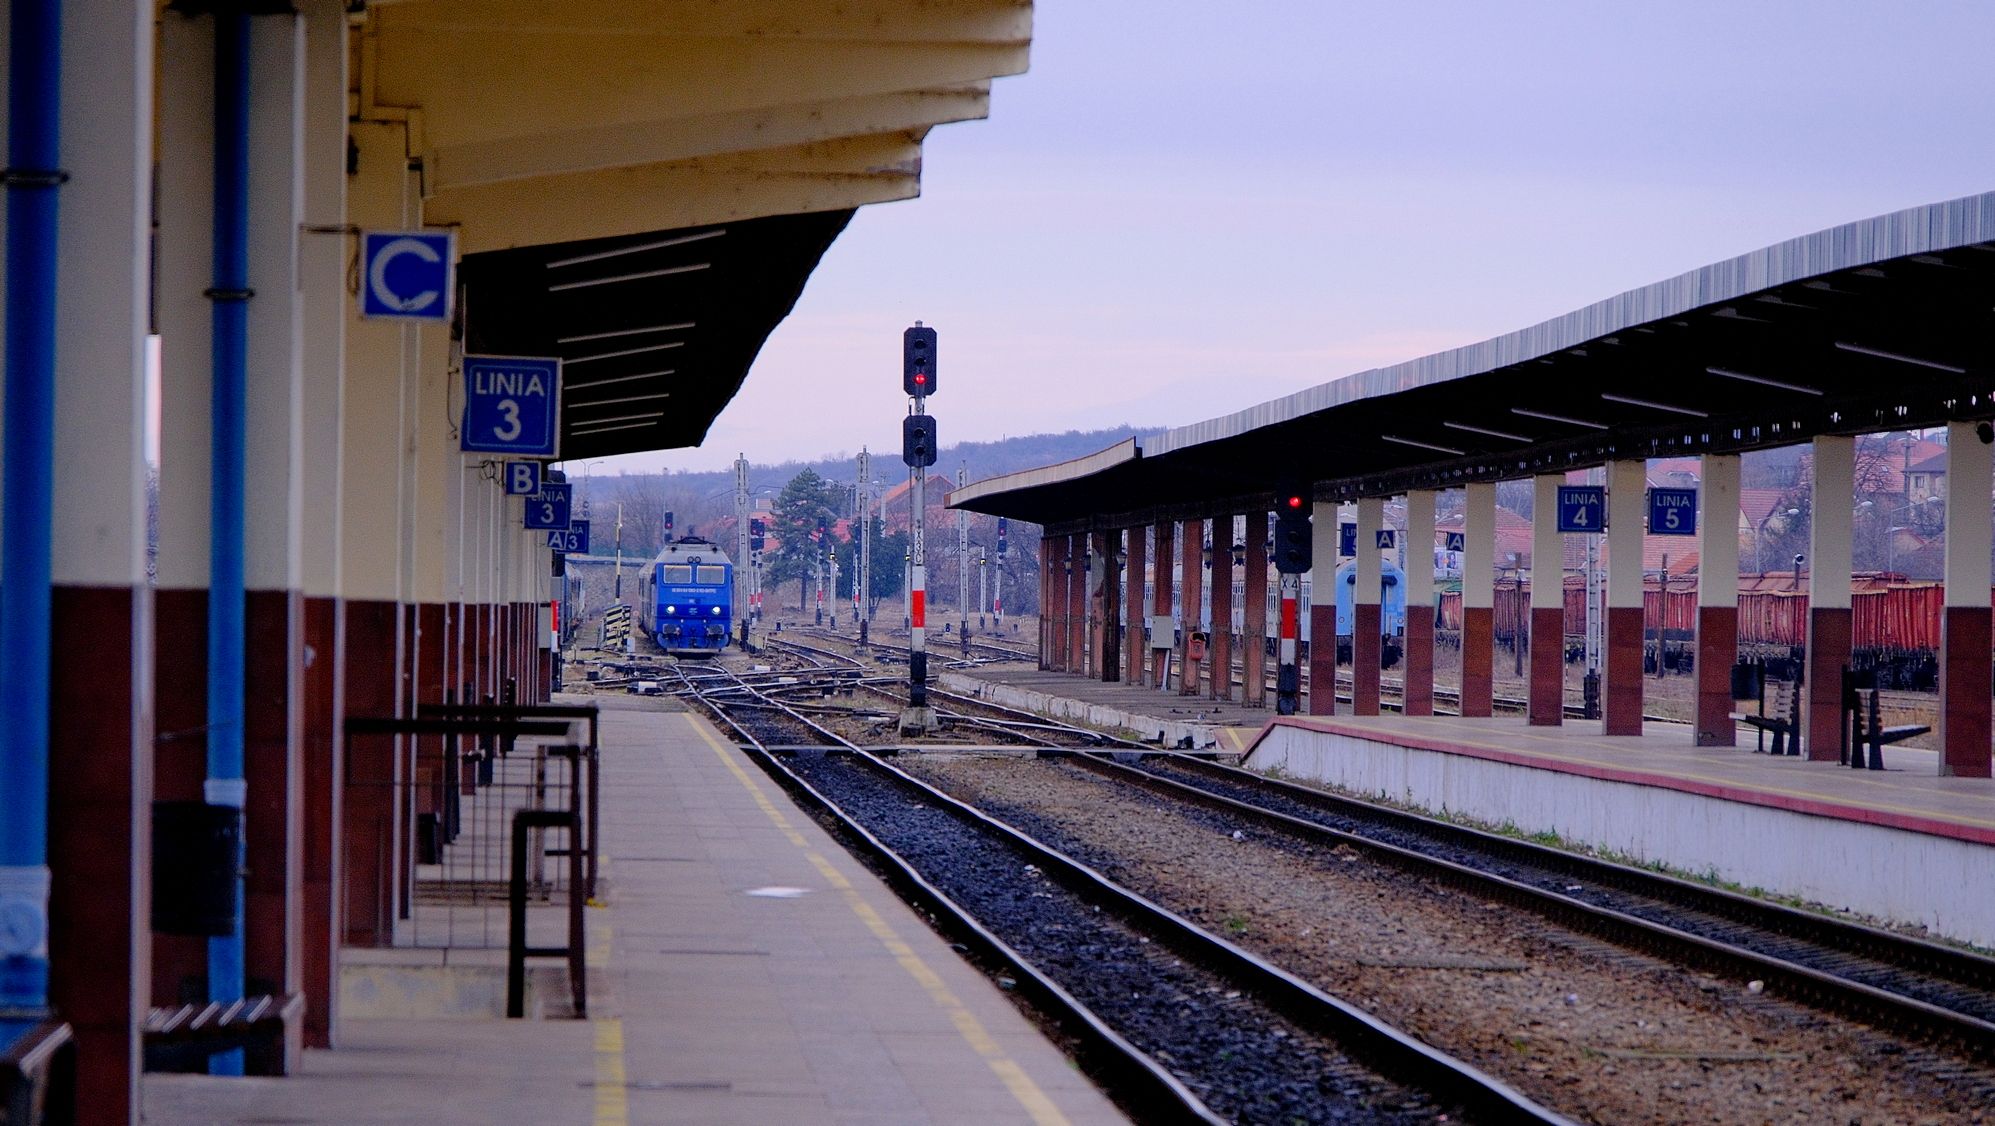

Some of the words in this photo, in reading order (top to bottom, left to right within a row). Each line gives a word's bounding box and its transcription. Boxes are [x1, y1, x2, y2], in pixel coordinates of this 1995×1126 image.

[369, 238, 440, 311] C
[476, 372, 545, 397] LINIA
[494, 399, 521, 441] 3
[514, 465, 533, 493] B
[1564, 493, 1598, 505] LINIA
[1656, 495, 1690, 507] LINIA
[541, 503, 555, 524] 3
[1573, 506, 1588, 527] 4
[1665, 508, 1679, 529] 5
[549, 532, 563, 548] A
[568, 535, 578, 550] 3
[1378, 532, 1393, 548] A
[1450, 534, 1464, 551] A
